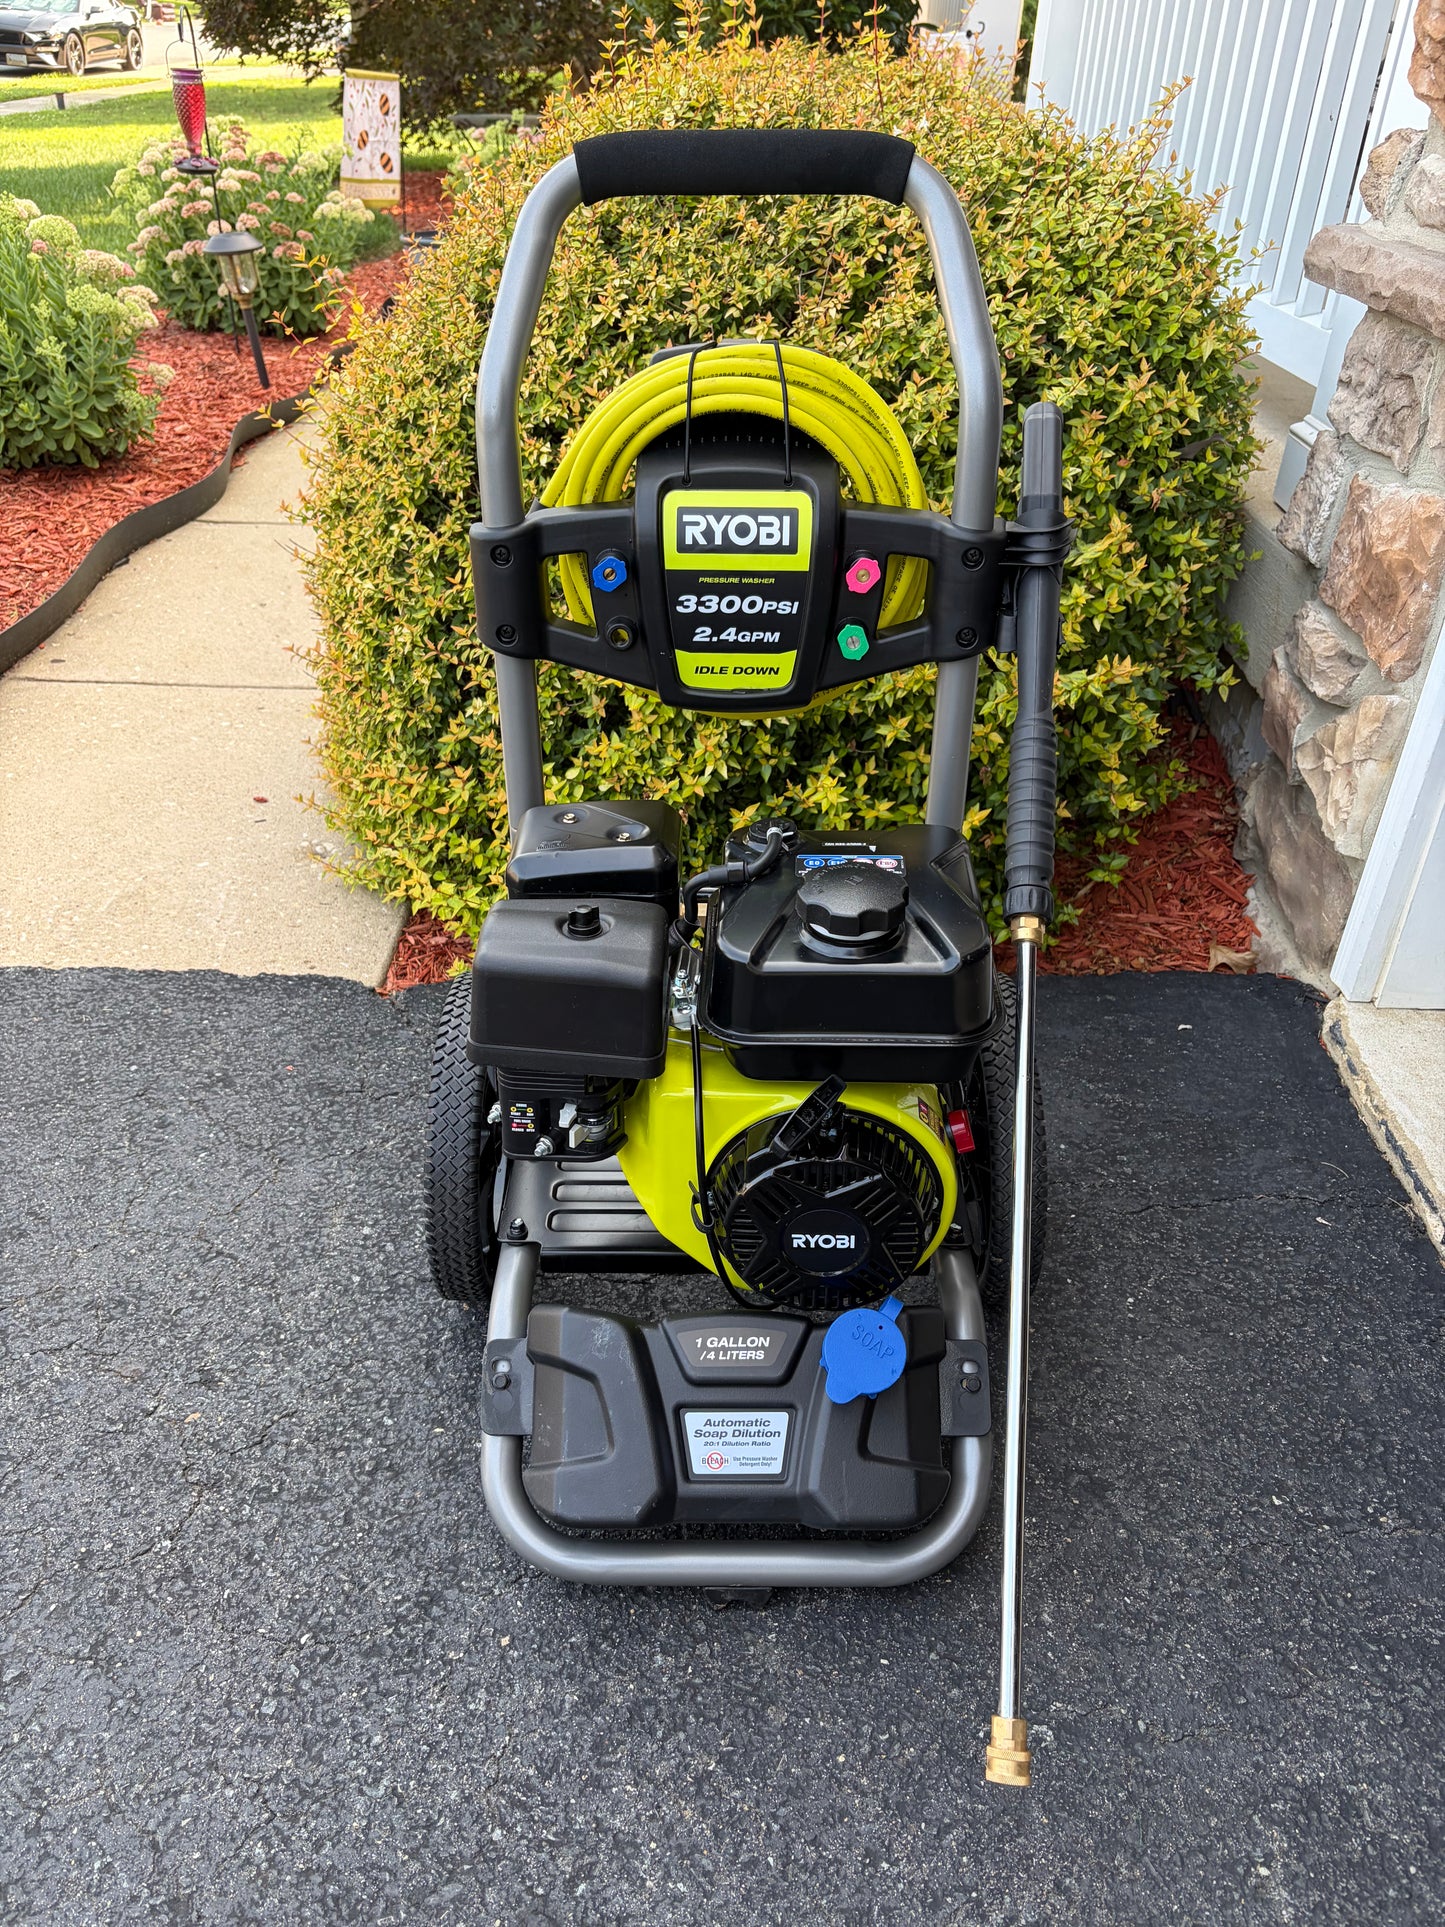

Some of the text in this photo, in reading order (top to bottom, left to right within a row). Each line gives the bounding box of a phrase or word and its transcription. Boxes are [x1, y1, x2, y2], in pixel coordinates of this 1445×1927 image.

[682, 514, 790, 546] RYOBI
[676, 595, 799, 614] 3300PSI
[692, 627, 780, 643] 2.4GPM
[694, 666, 780, 675] IDLE DOWN
[791, 1234, 855, 1249] RYOBI
[695, 1336, 770, 1348] 1 GALLON
[852, 1325, 895, 1359] SOAP
[719, 1350, 765, 1360] LITERS
[703, 1418, 771, 1427] Automatic
[693, 1428, 781, 1440] Soap Dilution
